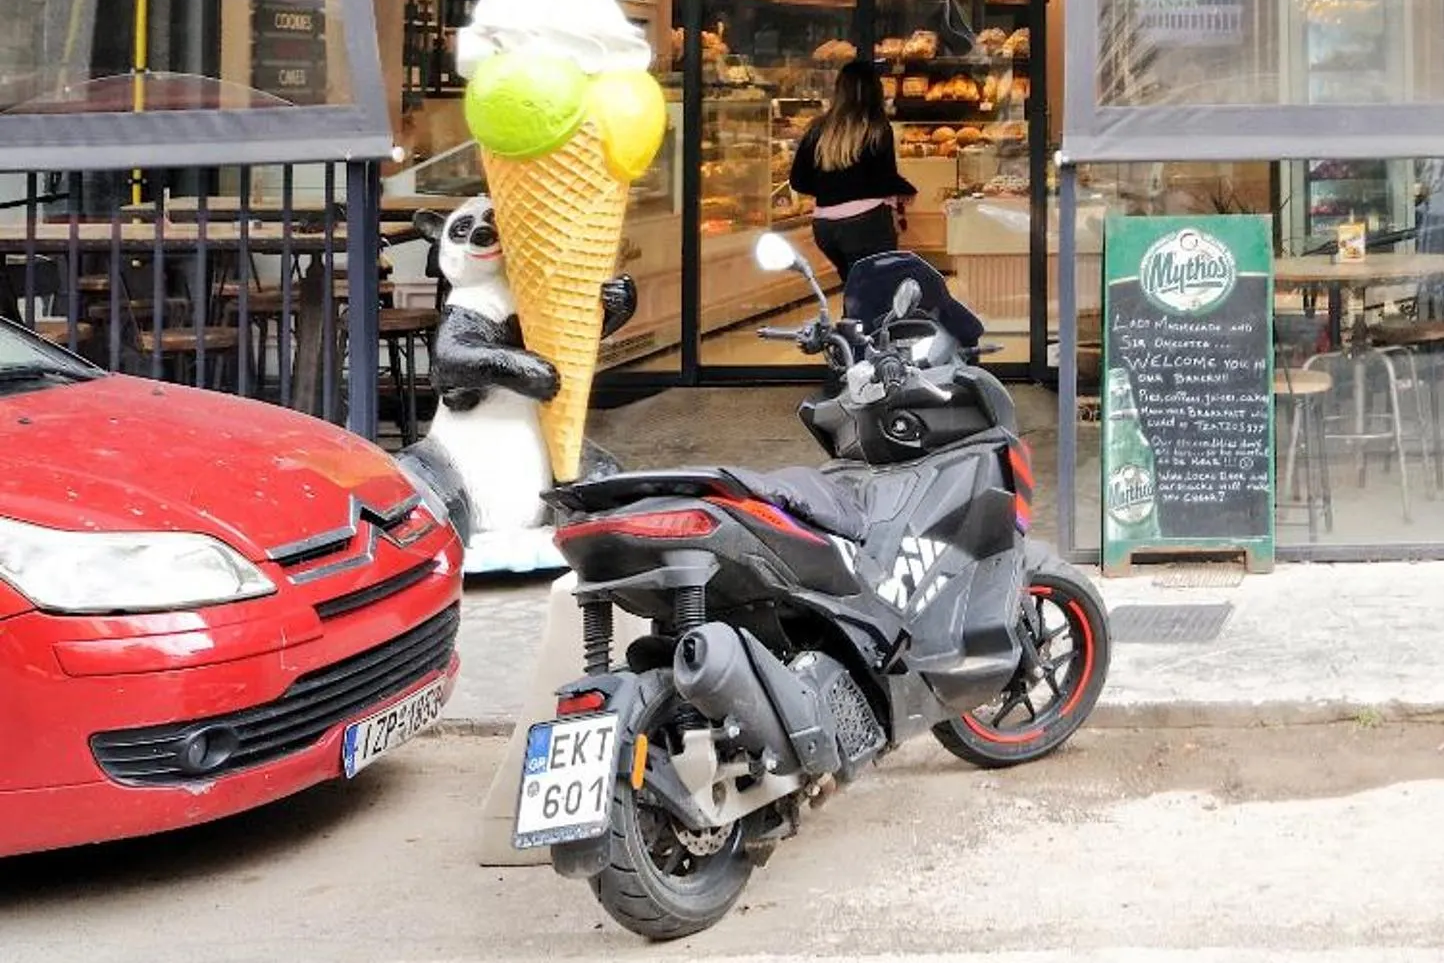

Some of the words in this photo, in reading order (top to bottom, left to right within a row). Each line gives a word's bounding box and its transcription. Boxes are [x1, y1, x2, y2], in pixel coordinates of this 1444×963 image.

[1147, 252, 1228, 293] Mythos
[1122, 351, 1217, 370] WELCOME
[1224, 359, 1248, 370] YOU
[550, 727, 613, 770] EKT
[542, 776, 605, 819] 601
